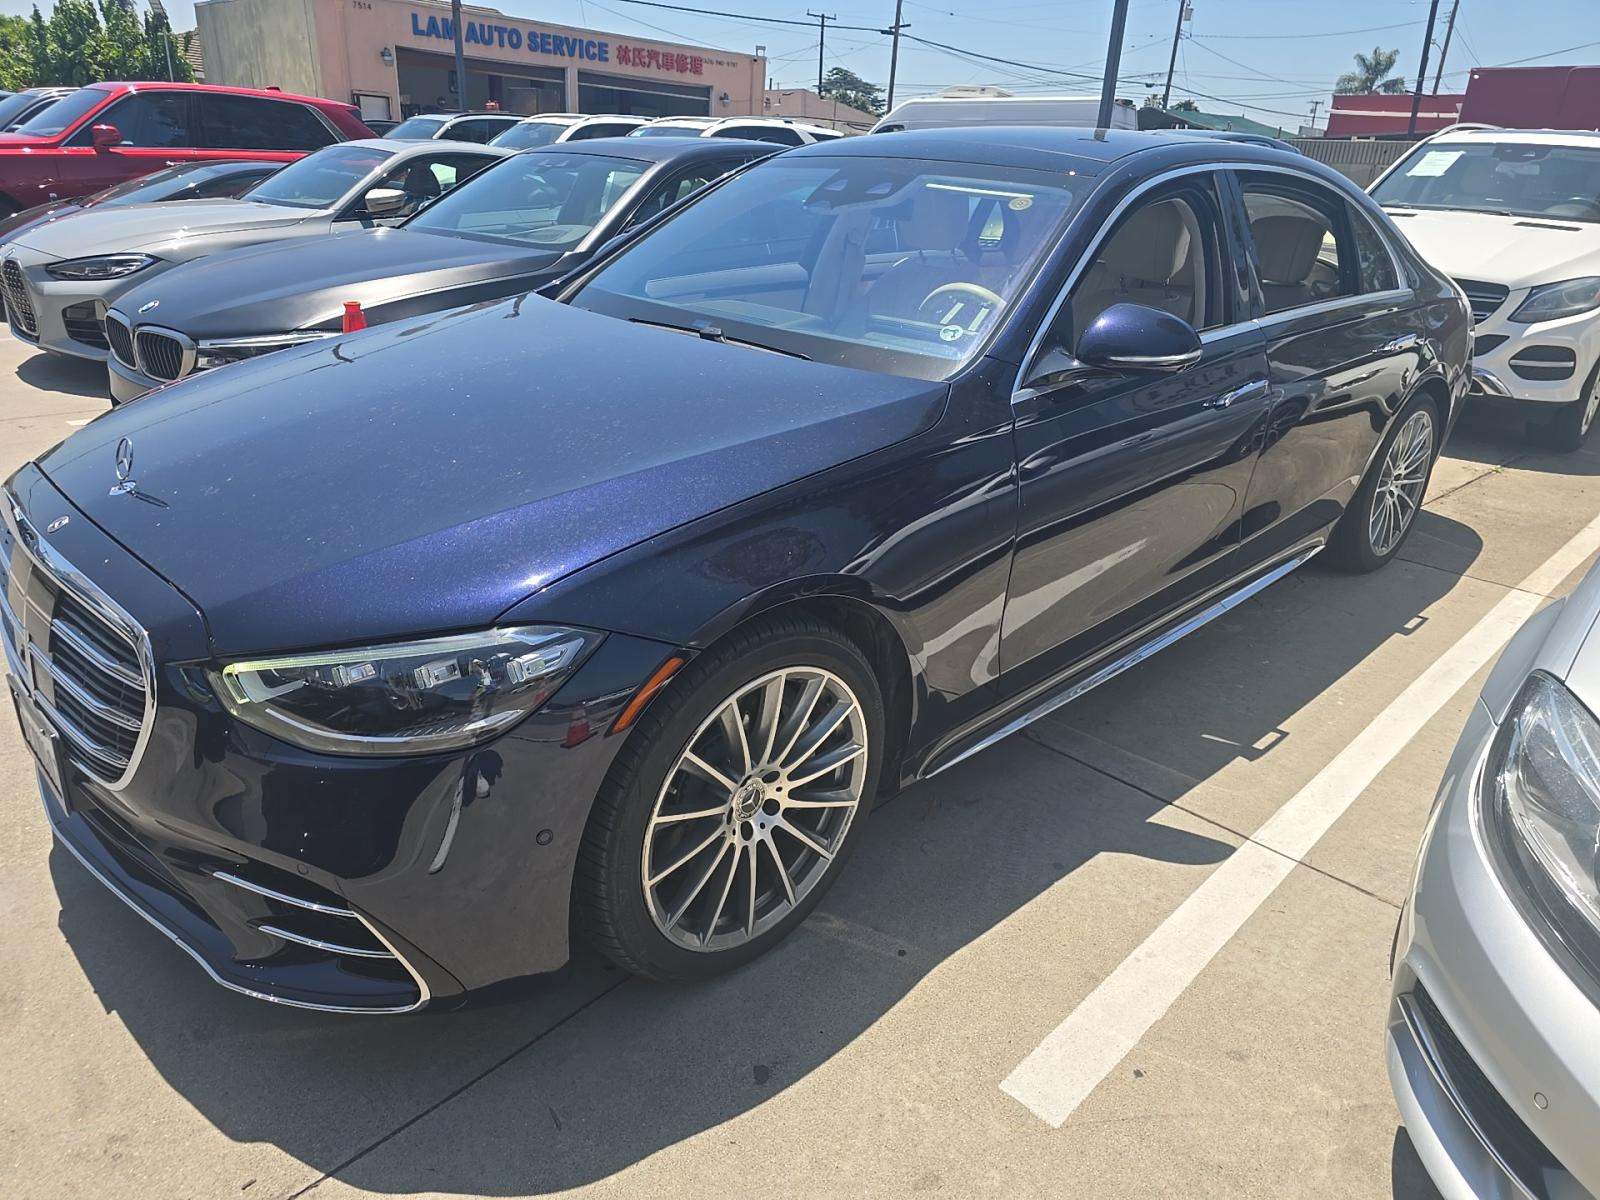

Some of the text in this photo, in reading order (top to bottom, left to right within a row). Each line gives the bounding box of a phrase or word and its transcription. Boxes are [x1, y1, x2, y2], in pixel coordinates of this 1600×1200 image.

[465, 21, 523, 49] AUTO
[527, 31, 609, 62] SERVICE
[616, 44, 704, 75] 林氏汽車修理
